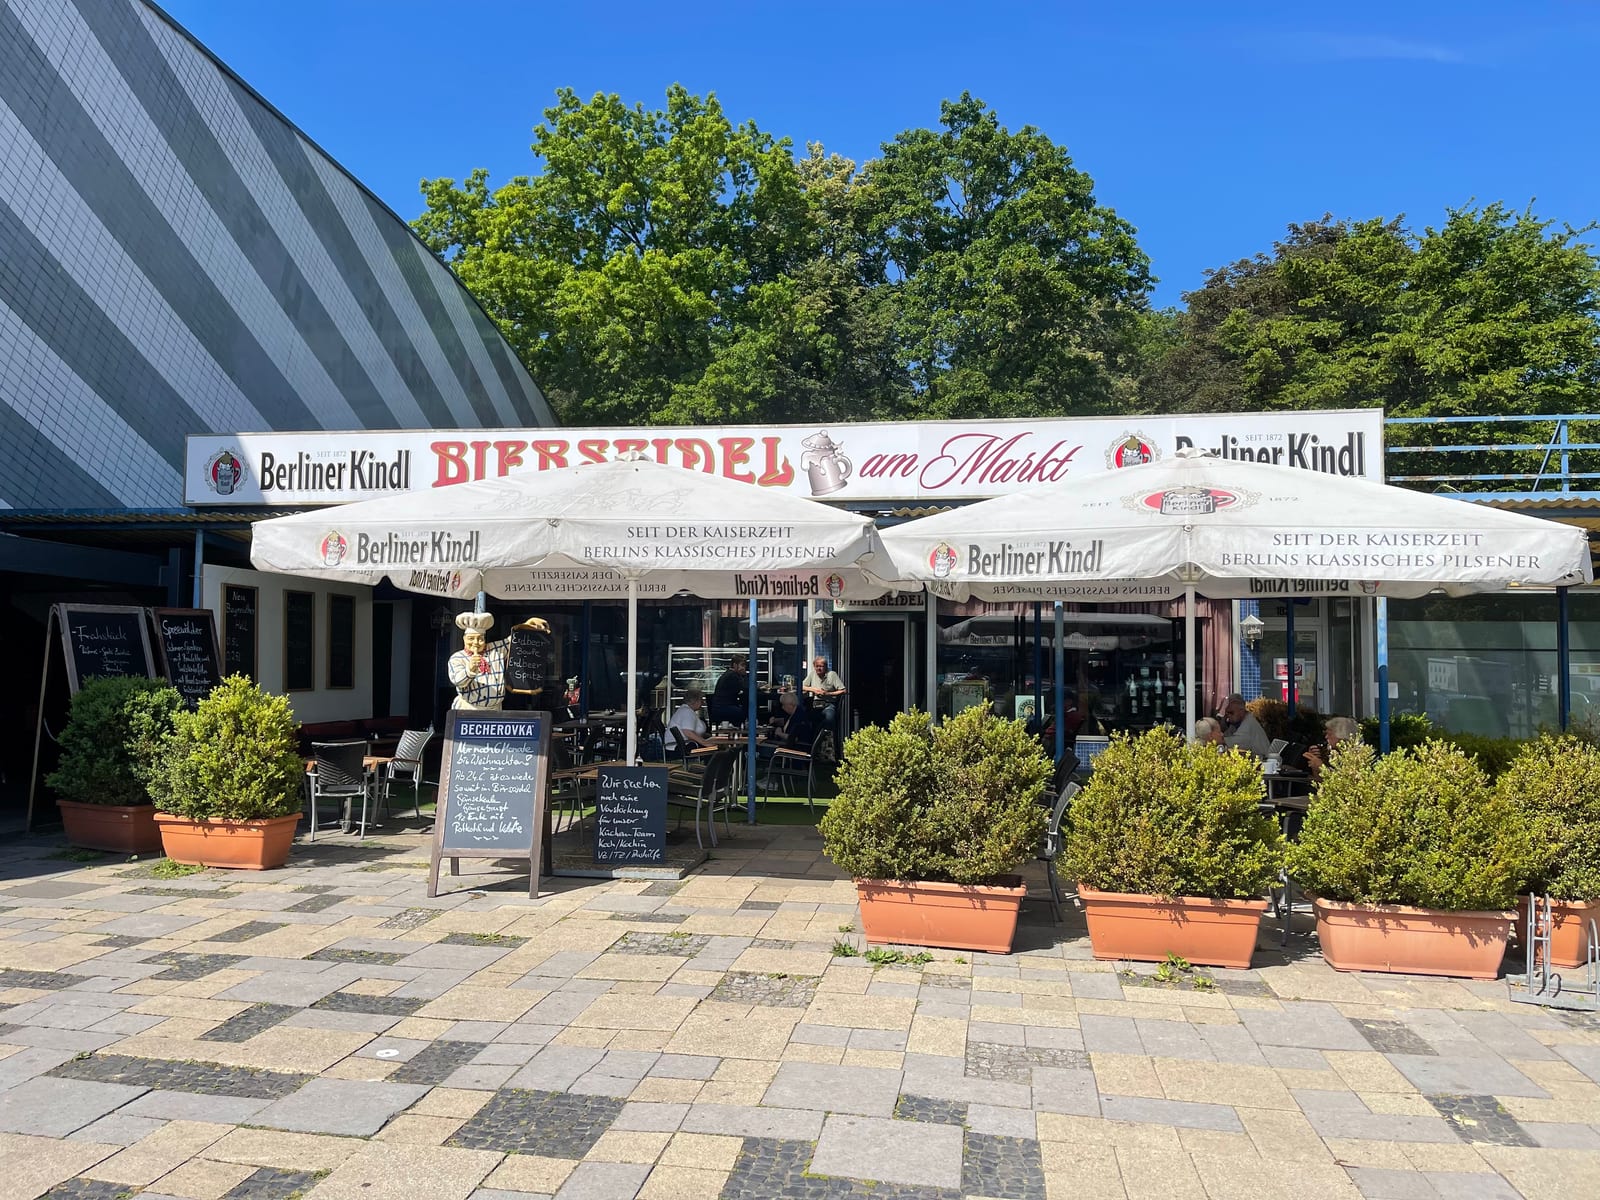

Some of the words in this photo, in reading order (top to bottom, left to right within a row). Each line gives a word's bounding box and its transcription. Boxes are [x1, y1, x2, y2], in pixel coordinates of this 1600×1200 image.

[1245, 434, 1262, 442] SEIT
[1265, 433, 1283, 441] 1872
[332, 450, 347, 458] 1872
[858, 452, 918, 478] am
[919, 431, 1083, 489] Markt
[1288, 431, 1365, 477] Kindl
[260, 451, 346, 490] Berliner
[350, 450, 411, 489] Kindl
[627, 526, 660, 538] SEIT
[666, 526, 698, 538] DER
[703, 526, 794, 539] KAISERZEIT
[358, 532, 428, 563] Berliner
[431, 530, 479, 562] Kindl
[1272, 533, 1313, 546] SEIT
[1319, 533, 1361, 546] DER
[1366, 533, 1484, 547] KAISERZEIT
[584, 546, 648, 558] BERLINS
[654, 546, 756, 558] KLASSISCHES
[762, 546, 837, 559] PILSENER
[967, 543, 1045, 576] Berliner
[1048, 539, 1103, 574] Kindl
[1221, 552, 1298, 566] BERLINS
[1306, 553, 1435, 567] KLASSISCHES
[1443, 554, 1541, 569] PILSENER
[513, 633, 545, 647] Erdbeer
[510, 657, 542, 669] Erdbeer
[515, 671, 543, 683] Spritz
[461, 724, 533, 736] BECHEROVKA
[474, 743, 494, 754] noch
[457, 755, 470, 765] bis
[602, 775, 621, 789] Wir
[624, 776, 661, 789] suchen
[601, 792, 618, 801] noch
[598, 815, 611, 825] für
[632, 828, 656, 838] Team
